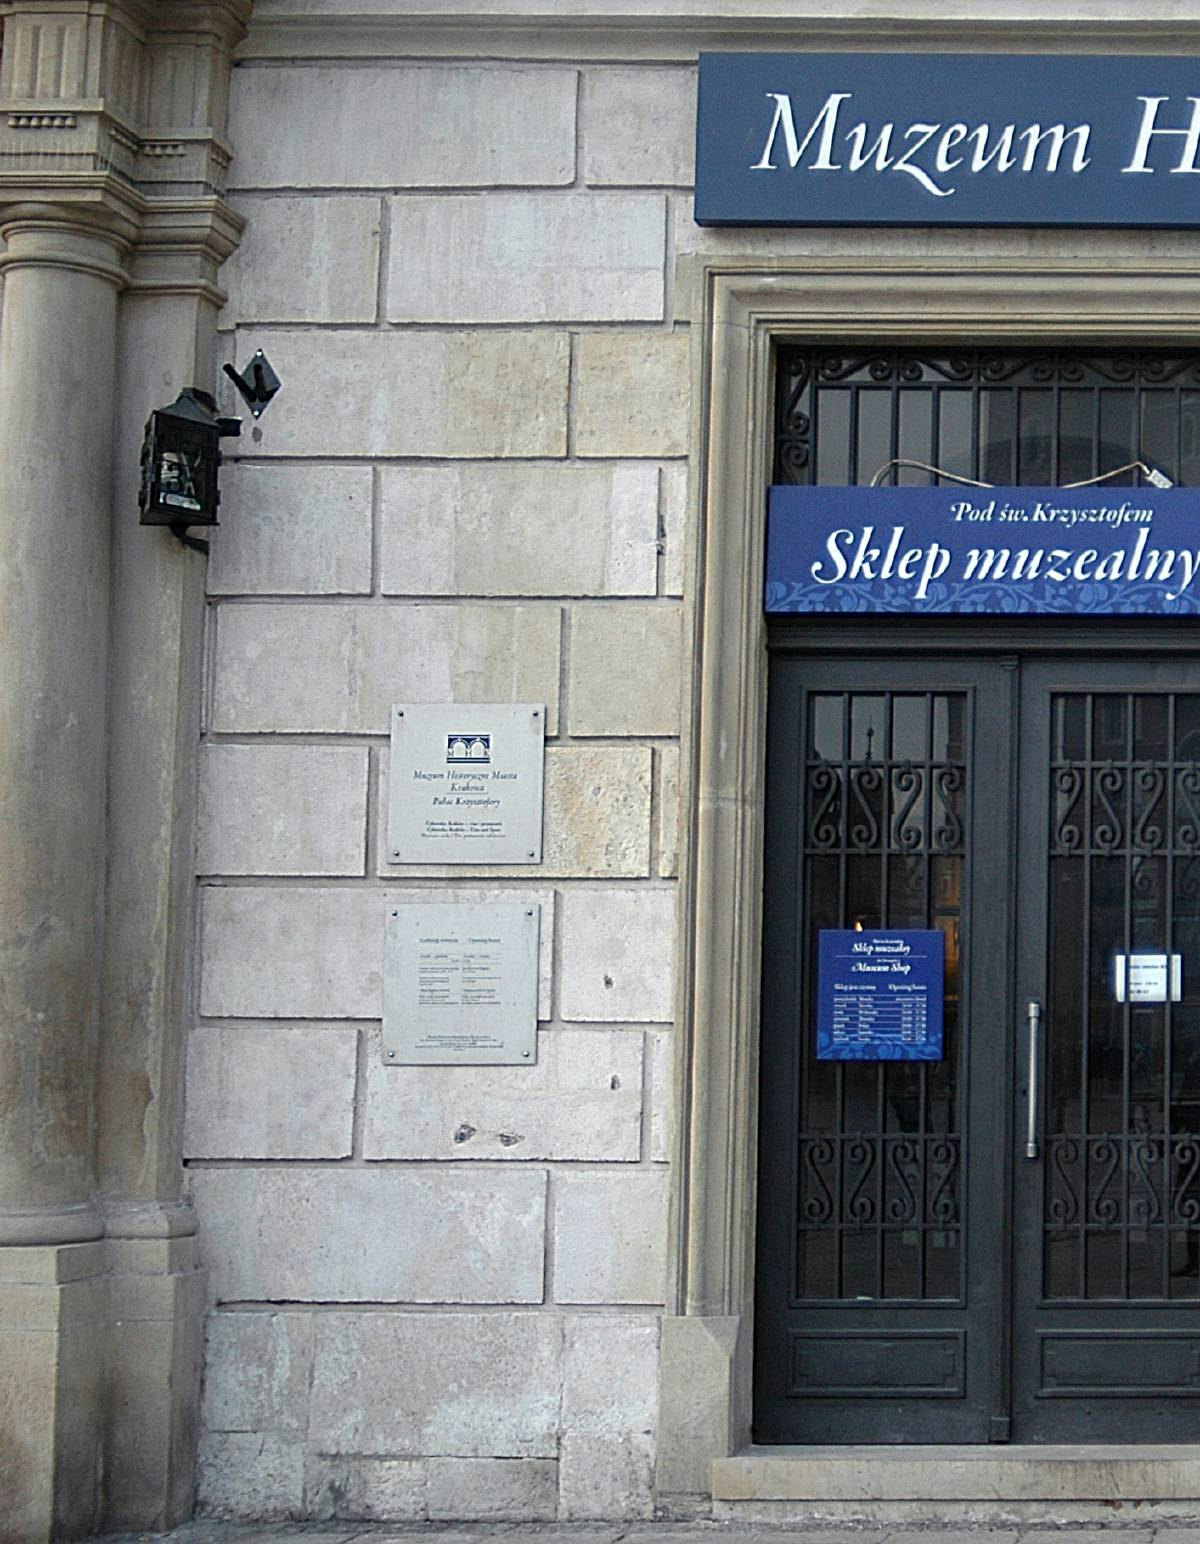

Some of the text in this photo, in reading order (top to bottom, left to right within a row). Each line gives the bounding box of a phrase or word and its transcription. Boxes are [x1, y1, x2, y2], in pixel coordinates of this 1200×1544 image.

[750, 91, 1091, 196] Muzeum
[951, 501, 1154, 528] Pod św. Krzysztofem
[810, 526, 951, 600] Sklep
